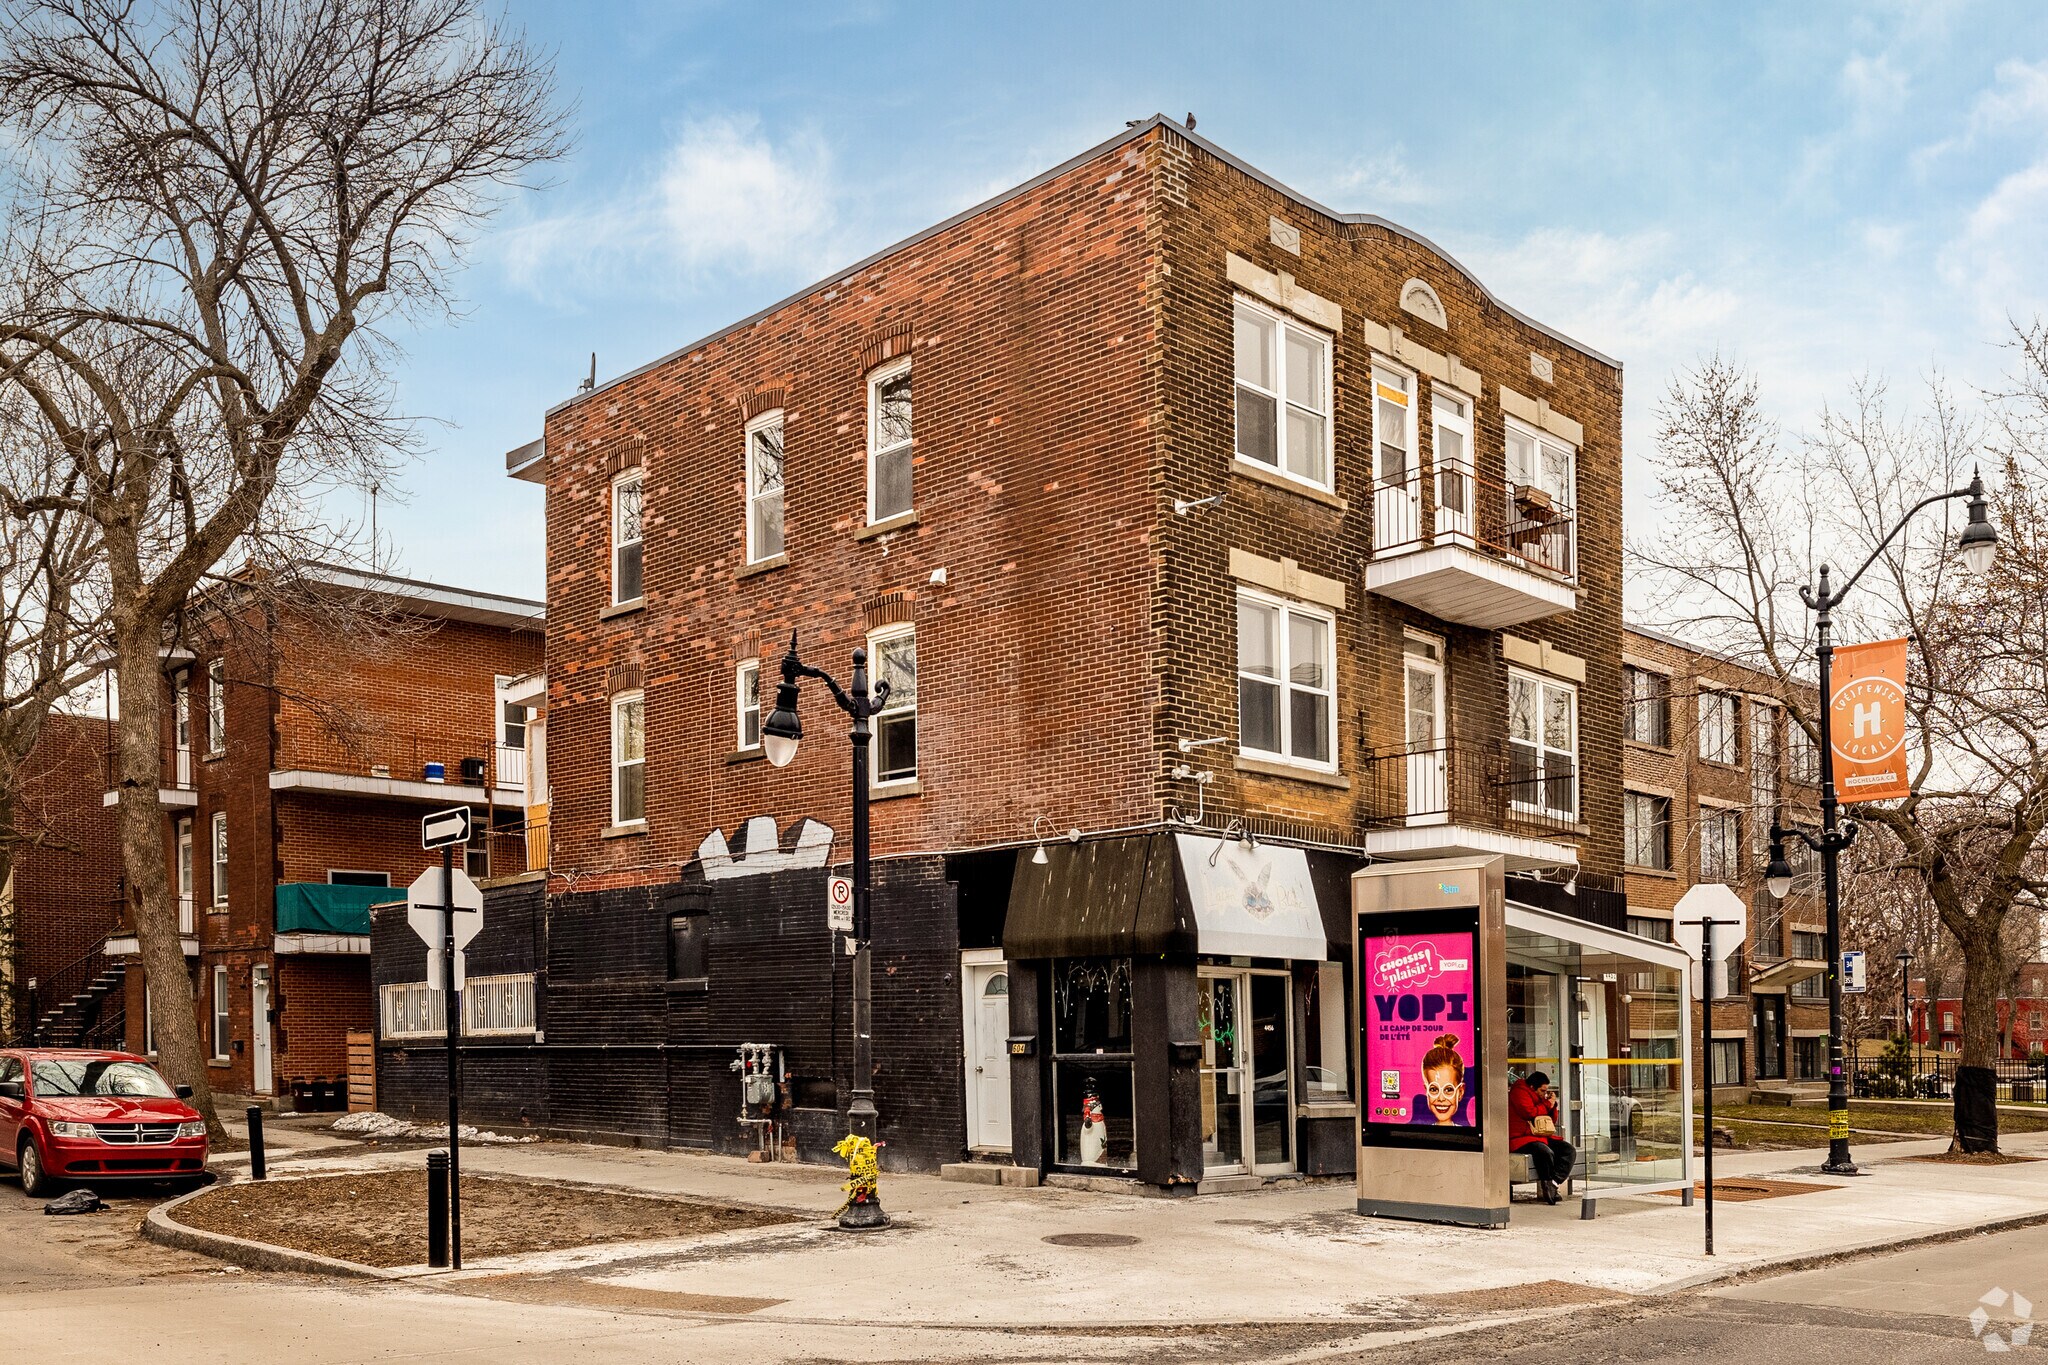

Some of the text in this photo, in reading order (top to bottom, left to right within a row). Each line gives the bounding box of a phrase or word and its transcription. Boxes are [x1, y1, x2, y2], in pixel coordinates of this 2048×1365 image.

[1854, 701, 1881, 739] H
[1380, 951, 1425, 972] CHOISIS
[1374, 993, 1468, 1022] YOPI
[1013, 1044, 1024, 1053] 604
